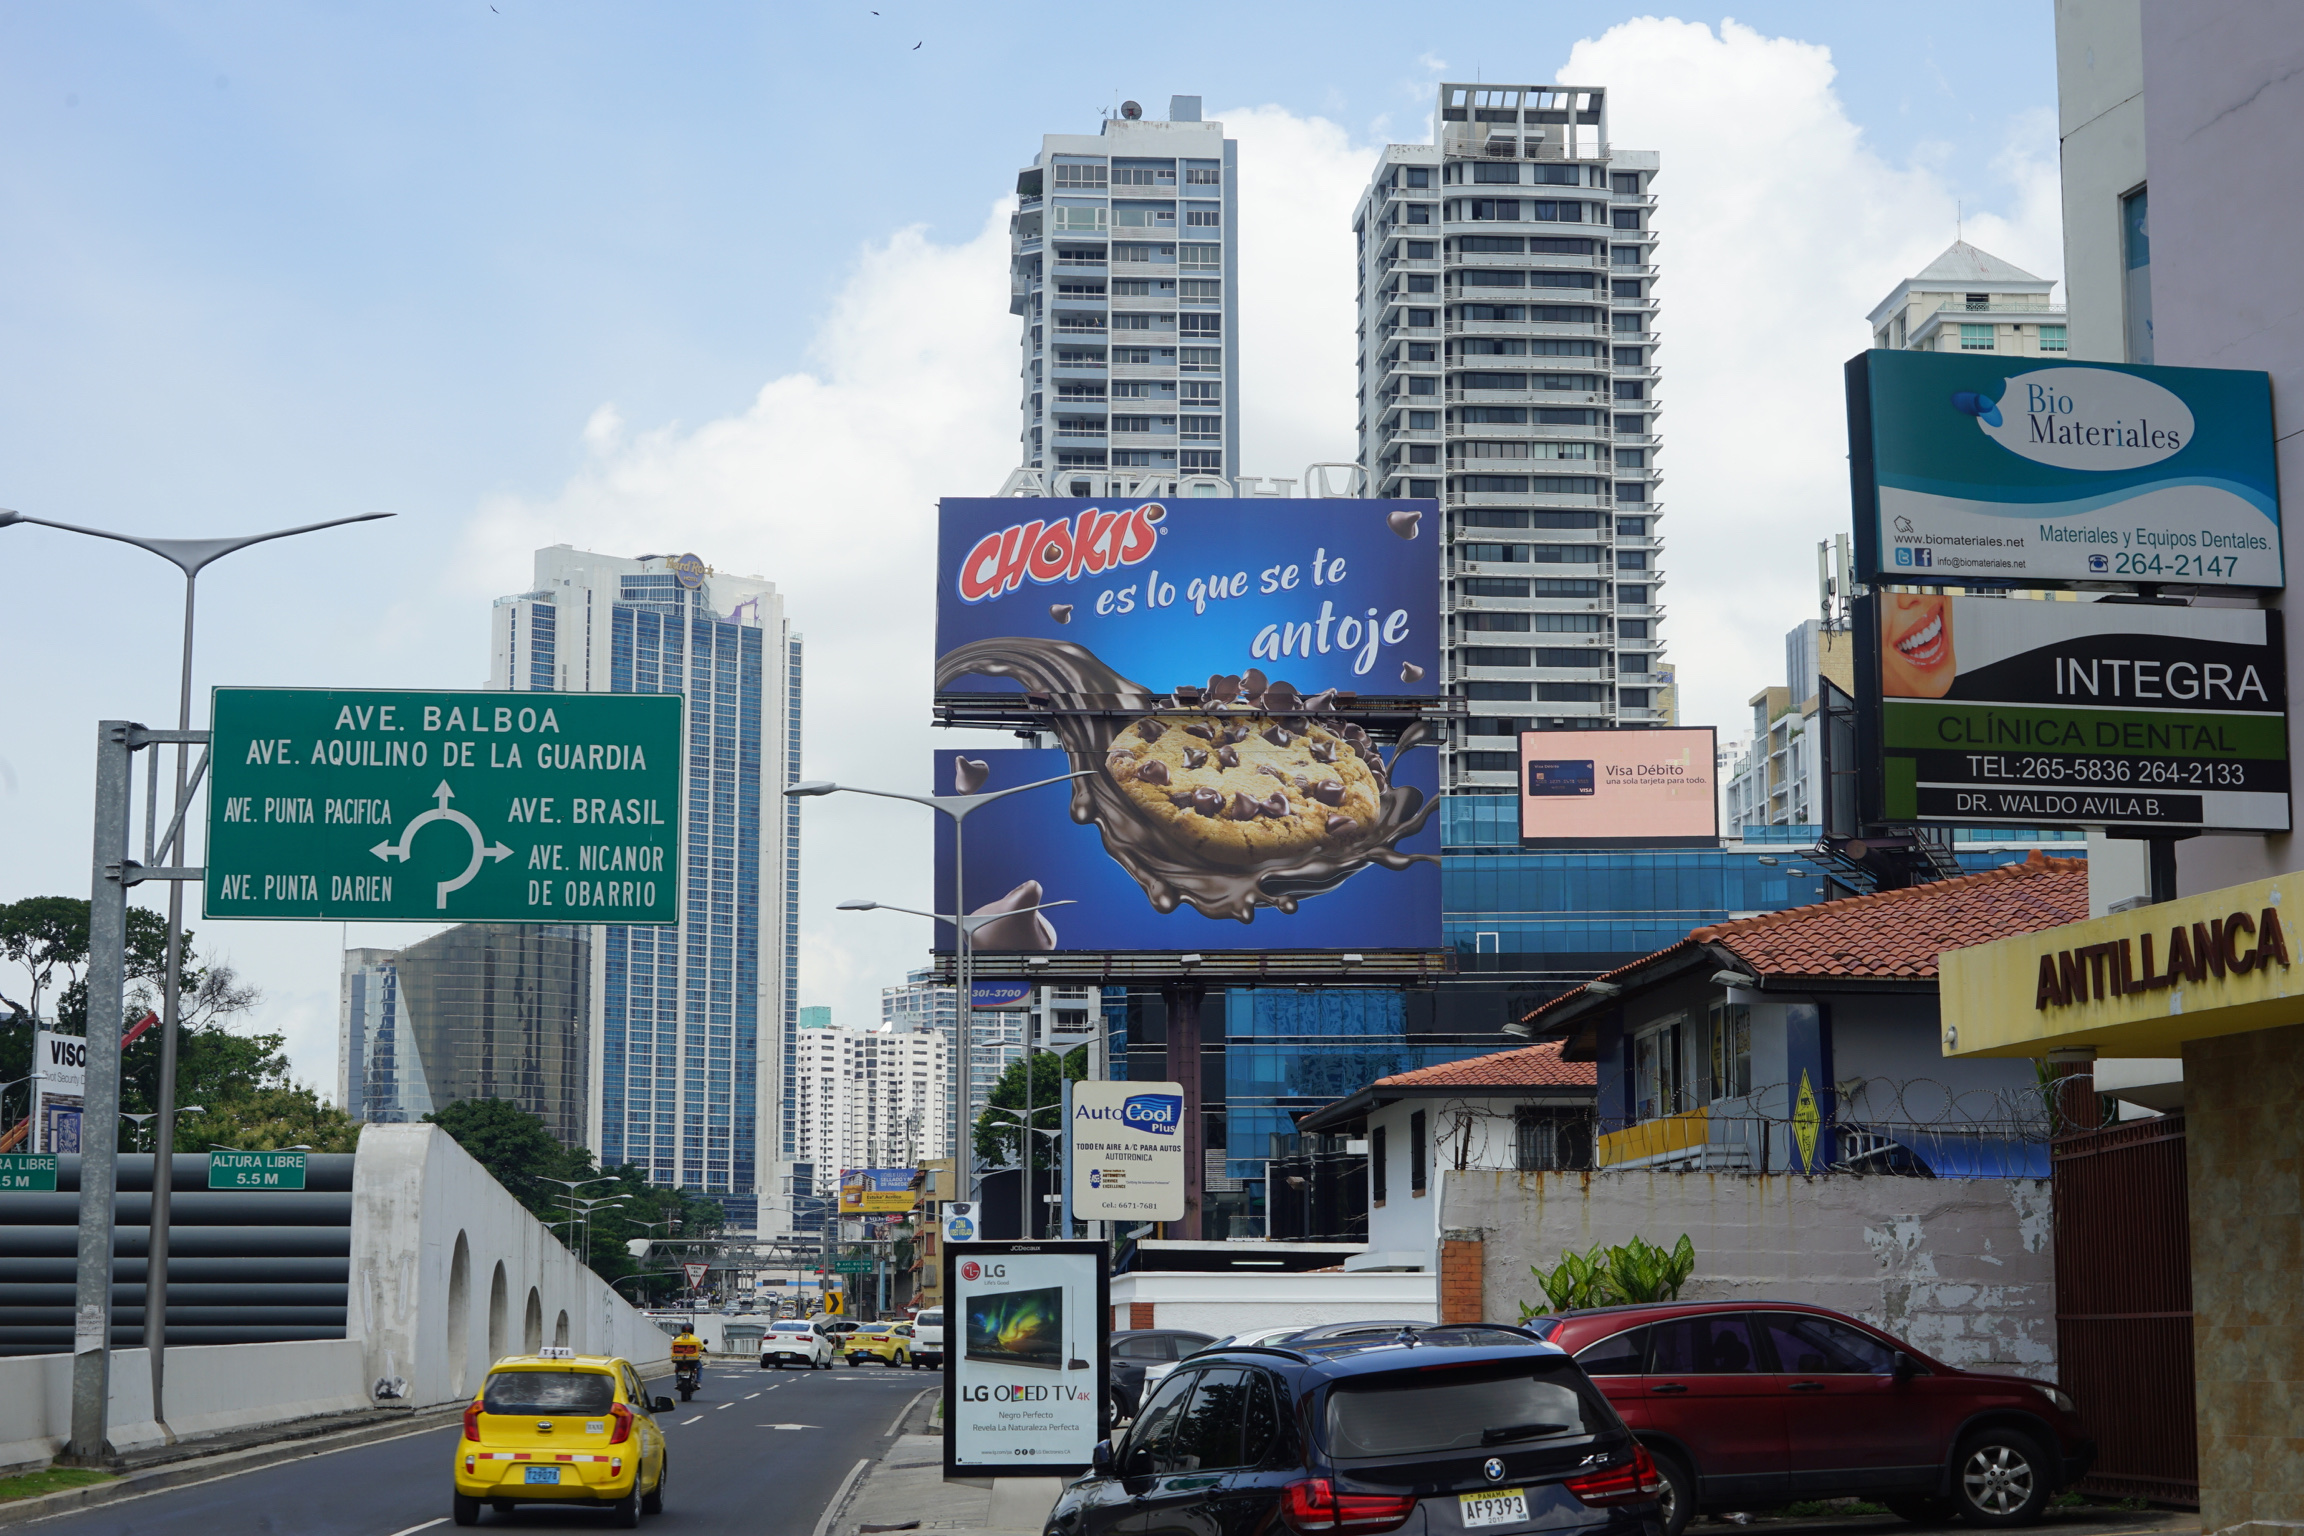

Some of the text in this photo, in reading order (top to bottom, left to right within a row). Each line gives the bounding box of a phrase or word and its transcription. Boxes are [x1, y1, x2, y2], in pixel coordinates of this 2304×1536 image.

[2026, 383, 2073, 415] Bio
[2029, 414, 2180, 449] Materiales
[1894, 534, 2024, 548] www.biomateriales.net
[2040, 525, 2271, 550] Materiales y Equipos Dentales.
[959, 503, 1167, 602] CHOKIS
[1937, 556, 2026, 569] info@biomateriales.net
[2115, 552, 2238, 577] 264-2147
[666, 557, 714, 578] Hard Rock
[1098, 548, 1346, 616] es lo que se te
[1251, 600, 1409, 675] antoje
[2056, 657, 2268, 701] INTEGRA
[335, 705, 560, 733] AVE. BALBOA
[1938, 713, 2236, 751] CLÍNICA DENTAL
[246, 739, 646, 771] AVE. AQUILINO DE LA GUARDIA
[1606, 763, 1683, 776] Visa Débito
[1967, 755, 2244, 785] TEL:265-5836 264-2133
[224, 797, 392, 825] AVE. PUNTA PACIFICA
[508, 798, 664, 825] AVE. BRASIL
[1957, 794, 2164, 816] DR. WALDO AVILA B.
[528, 845, 663, 872] AVE. NICANOR
[221, 874, 392, 902] AVE. PUNTA DARIEN
[528, 880, 655, 907] DE OBARRIO
[2036, 907, 2290, 1010] ANTILLANCA
[972, 989, 1021, 997] 301-3700
[58, 1072, 80, 1086] Security
[1152, 1124, 1175, 1133] Plus
[19, 1159, 55, 1170] LIBRE
[212, 1155, 303, 1167] ALTURA LIBRE
[1105, 1153, 1153, 1161] AUTOTRONICA
[16, 1176, 29, 1187] M
[237, 1173, 278, 1184] 5.5 M
[985, 1265, 1005, 1277] LG
[963, 1385, 989, 1402] LG
[994, 1385, 1048, 1402] OLED
[999, 1412, 1021, 1420] Negro
[1478, 1491, 1505, 1500] PANAMA
[1467, 1496, 1523, 1520] AF9393
